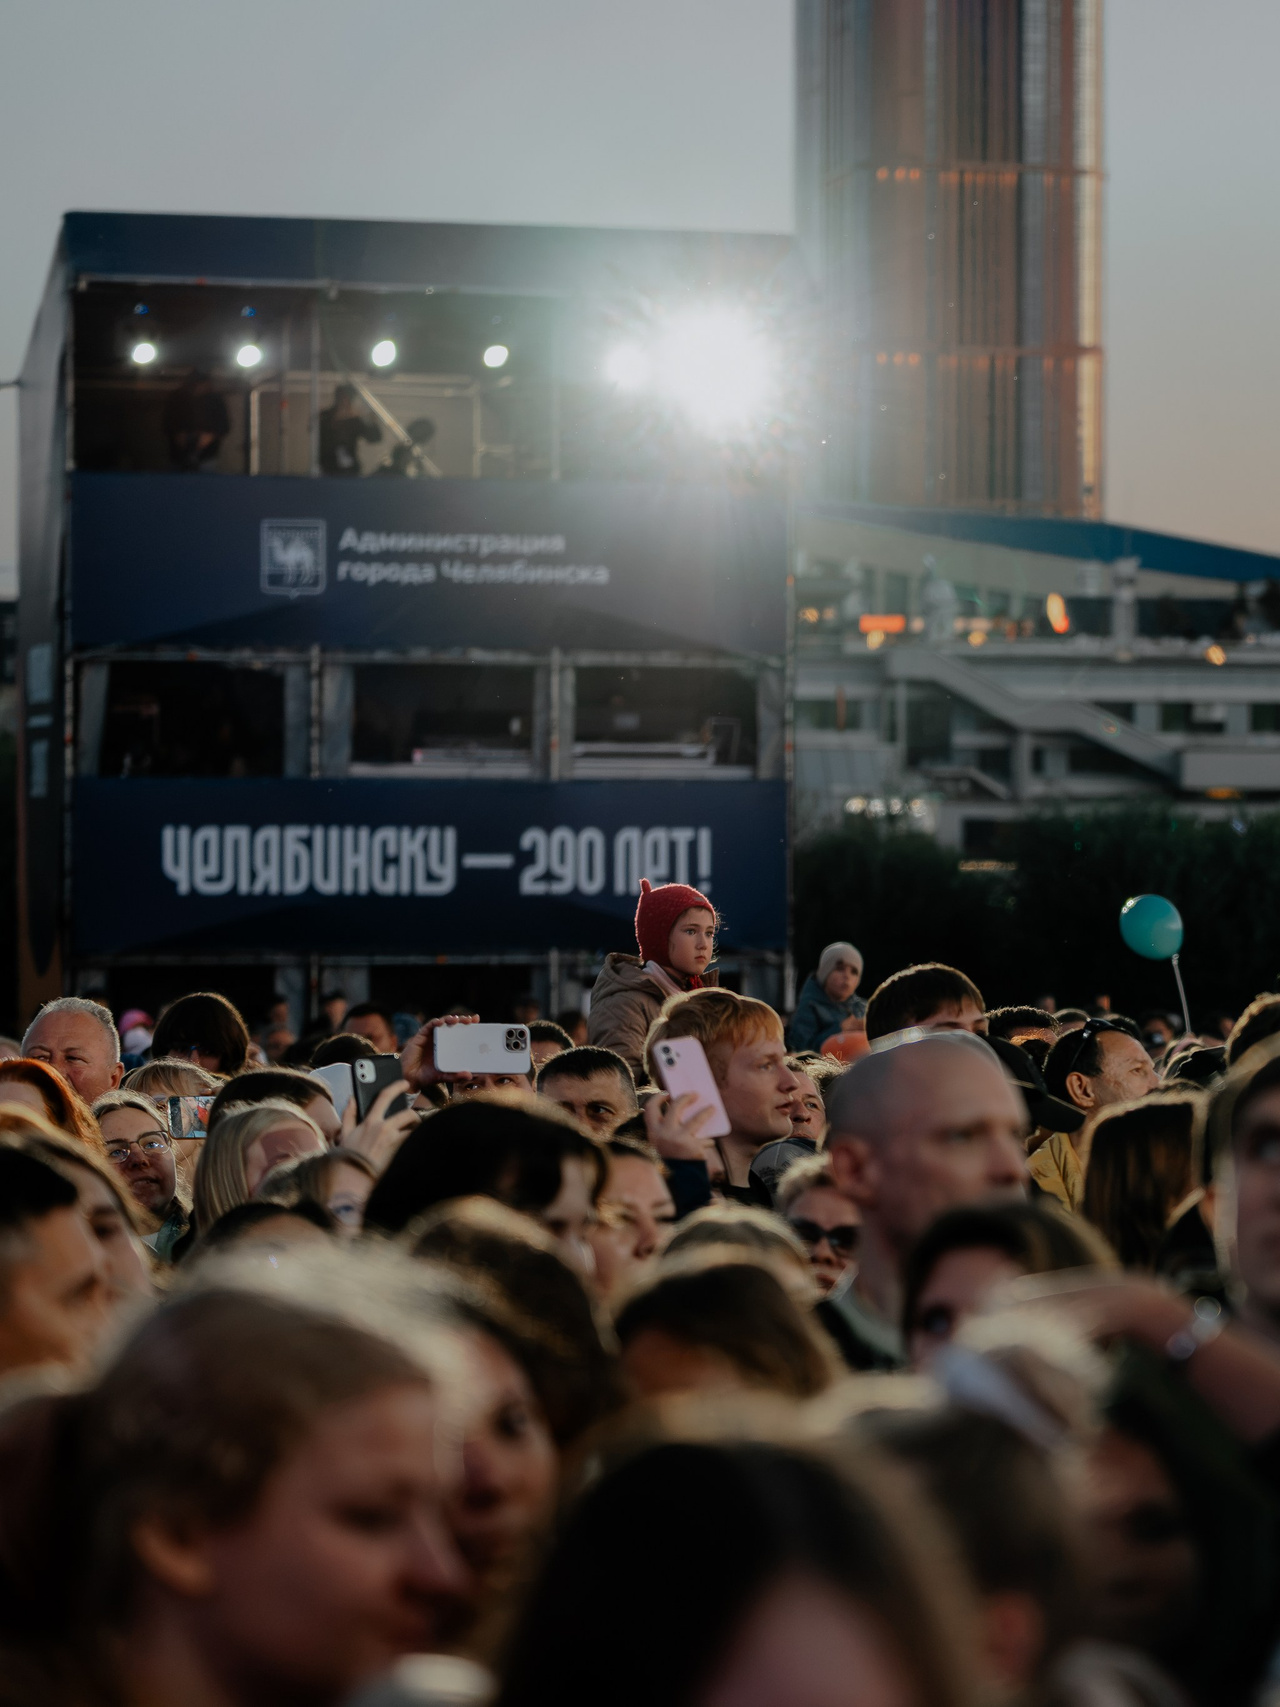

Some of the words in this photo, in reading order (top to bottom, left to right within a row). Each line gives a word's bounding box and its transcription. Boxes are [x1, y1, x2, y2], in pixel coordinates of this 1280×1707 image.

[338, 527, 566, 557] Администрация
[336, 560, 437, 586] города
[440, 559, 609, 585] Челябинска
[519, 826, 605, 896] 290
